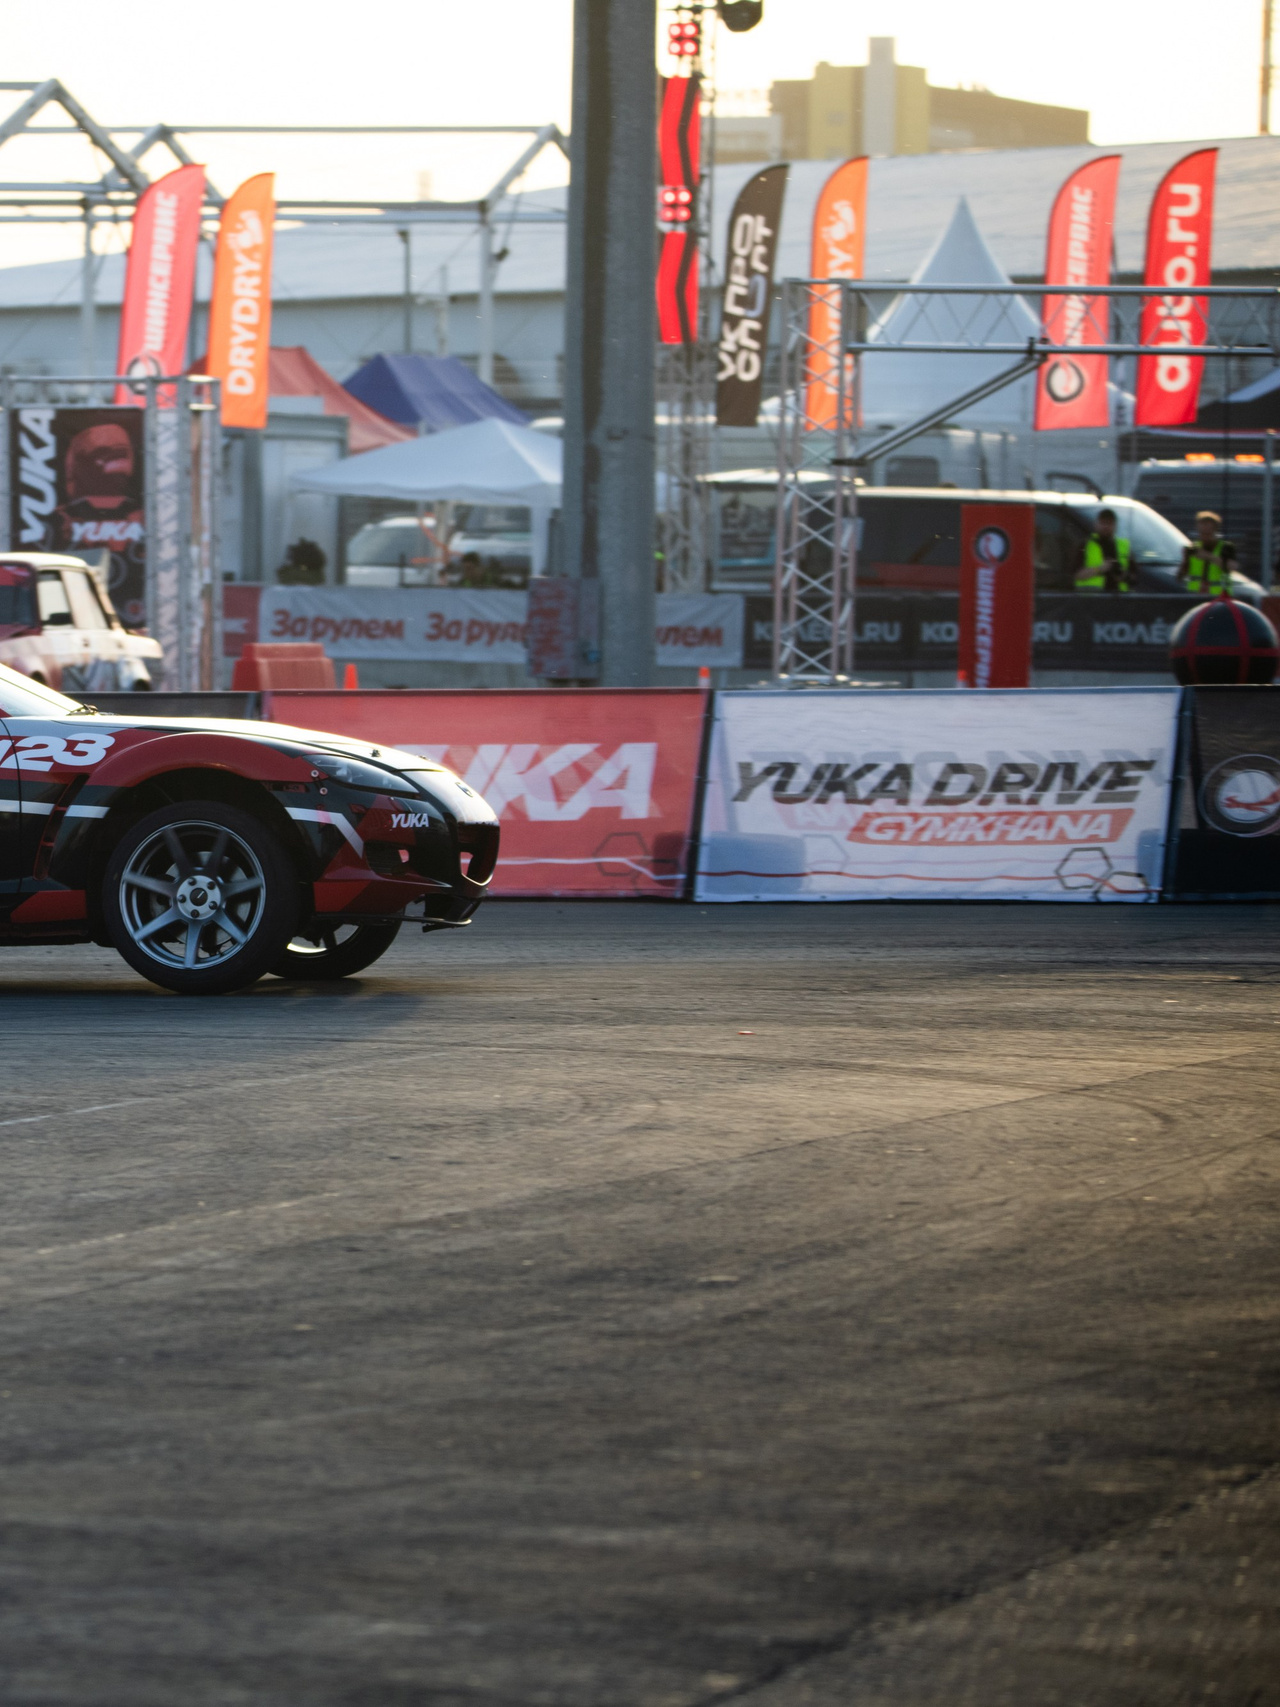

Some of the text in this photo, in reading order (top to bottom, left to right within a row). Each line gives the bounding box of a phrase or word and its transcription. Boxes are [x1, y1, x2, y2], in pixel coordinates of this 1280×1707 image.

[1156, 183, 1202, 392] auto.ru
[227, 253, 262, 394] DRYDRY
[20, 409, 56, 542] YUKA
[71, 521, 144, 542] YUKA
[733, 759, 1157, 806] YUKA DRIVE
[391, 813, 429, 828] YUKA
[866, 813, 1112, 843] GYMKHANA
